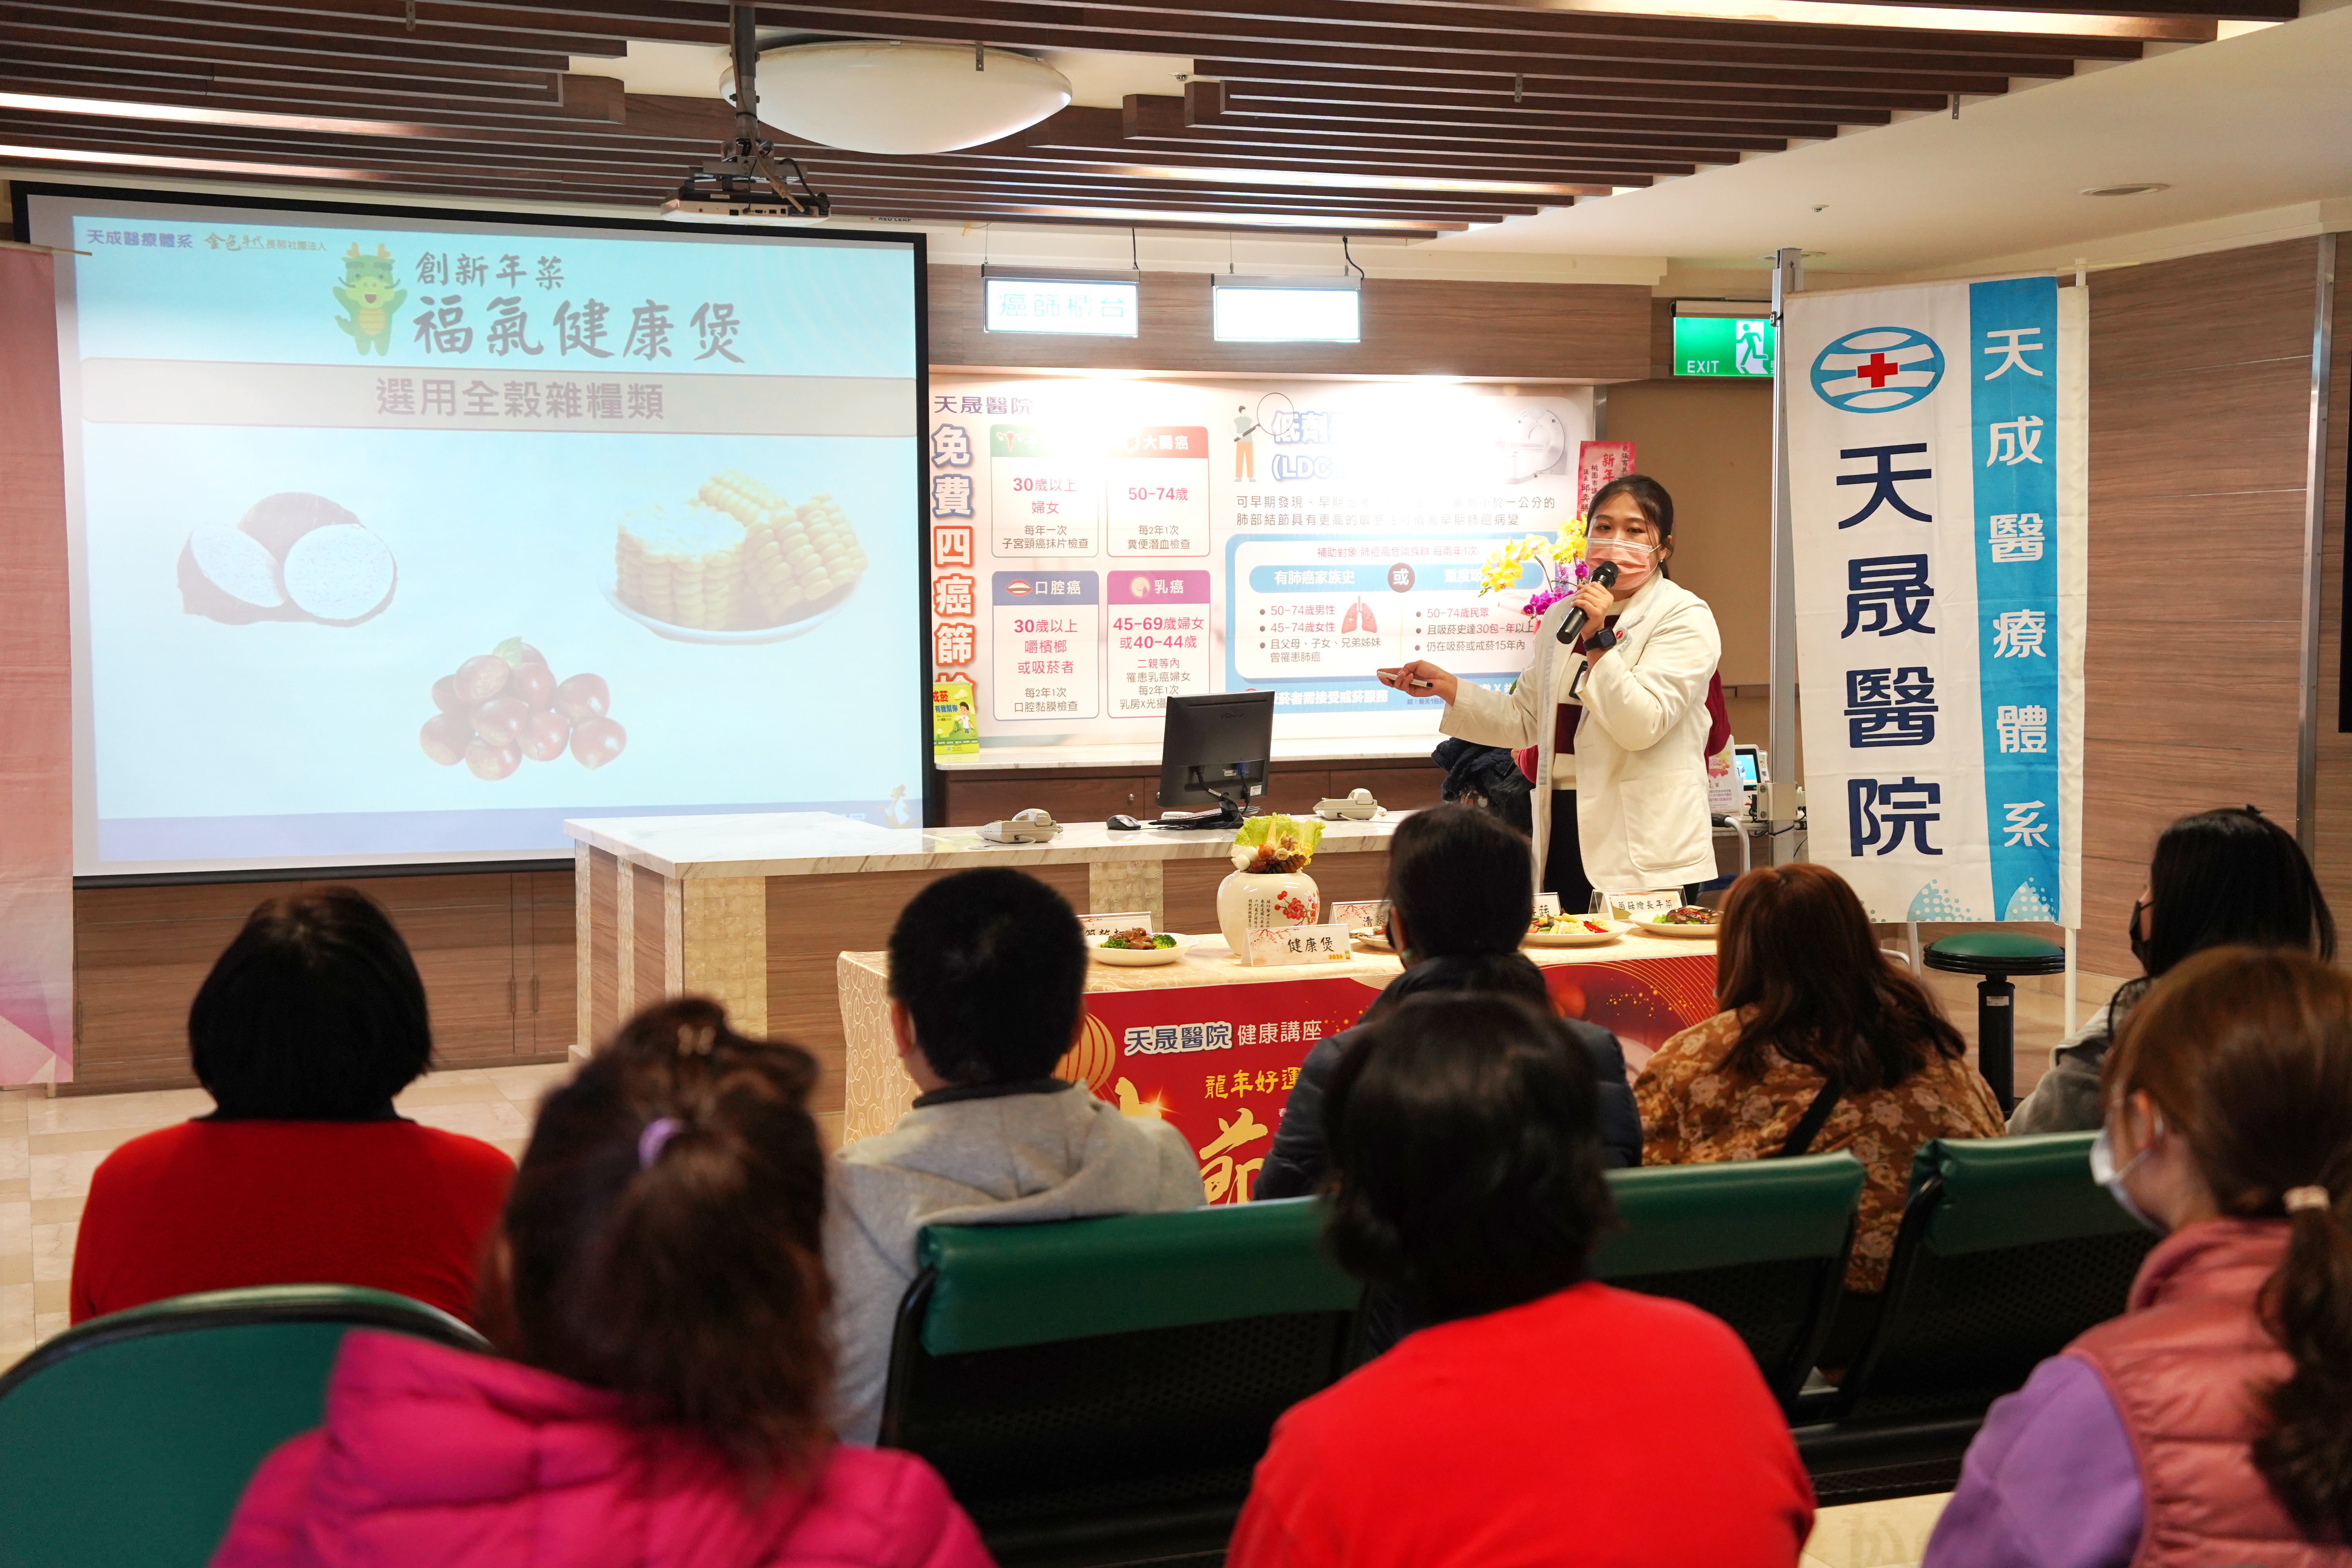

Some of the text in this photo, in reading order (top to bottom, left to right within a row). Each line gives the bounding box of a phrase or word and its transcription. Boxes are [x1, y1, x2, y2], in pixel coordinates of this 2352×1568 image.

[87, 229, 193, 249] 天成醫療體系
[415, 250, 565, 290] 創新年菜
[413, 293, 745, 364] 福氣健康煲
[1687, 360, 1719, 373] EXIT
[376, 377, 664, 421] 選用全穀雜糧類
[933, 395, 1033, 415] 天晟醫院
[1143, 434, 1189, 450] 大腸癌
[1602, 453, 1615, 483] 新年
[1013, 477, 1077, 493] 30歲以上
[1128, 487, 1188, 501] 50-74歲
[1031, 501, 1059, 515] 婦女
[1024, 524, 1067, 536] 每年一次
[1138, 524, 1179, 536] 每2年1次
[1002, 538, 1089, 550] 子宮頸癌抹片檢查
[1127, 538, 1191, 550] 糞便潛血檢查
[1317, 546, 1477, 557] 補助對象 肺癌高危險族群 每兩年1次
[931, 423, 976, 683] 免費四癌篩
[1274, 569, 1356, 585] 有肺癌家族史
[1393, 568, 1409, 585] 或
[1444, 568, 1487, 583] 重度吸
[1035, 580, 1081, 596] 口腔癌
[1154, 579, 1184, 595] 乳癌
[1984, 327, 2050, 848] 天成醫療體系
[1270, 604, 1335, 615] 50-74歲男性
[1427, 607, 1489, 618] 50-74歲民眾
[1013, 619, 1078, 634] 30歲以上
[1112, 616, 1205, 631] 45-69歲婦女
[1270, 621, 1335, 633] 45-74歲女性
[1427, 623, 1534, 635] 且吸菸史達30包-年以上
[1025, 639, 1067, 654] 嚼檳榔
[1119, 635, 1198, 650] 或40-44歲
[1270, 637, 1381, 649] 且父母、子女、兄弟姊妹
[1426, 639, 1525, 652] 仍在吸菸或戒菸15年內
[1836, 442, 1943, 857] 天晟醫院
[1137, 658, 1180, 669] 二親等內
[1270, 651, 1321, 663] 曾罹患肺癌
[1017, 660, 1074, 675] 或吸菸者
[1126, 671, 1191, 683] 罹患乳癌婦女
[1025, 687, 1067, 698] 每2年1次
[1138, 684, 1179, 696] 每2年1次
[1274, 689, 1388, 705] 菸者需接受戒菸服務
[1014, 700, 1078, 713] 口腔黏膜檢查
[1288, 936, 1335, 953] 健康煲
[1125, 1019, 1323, 1055] 天晟醫院 健康講座
